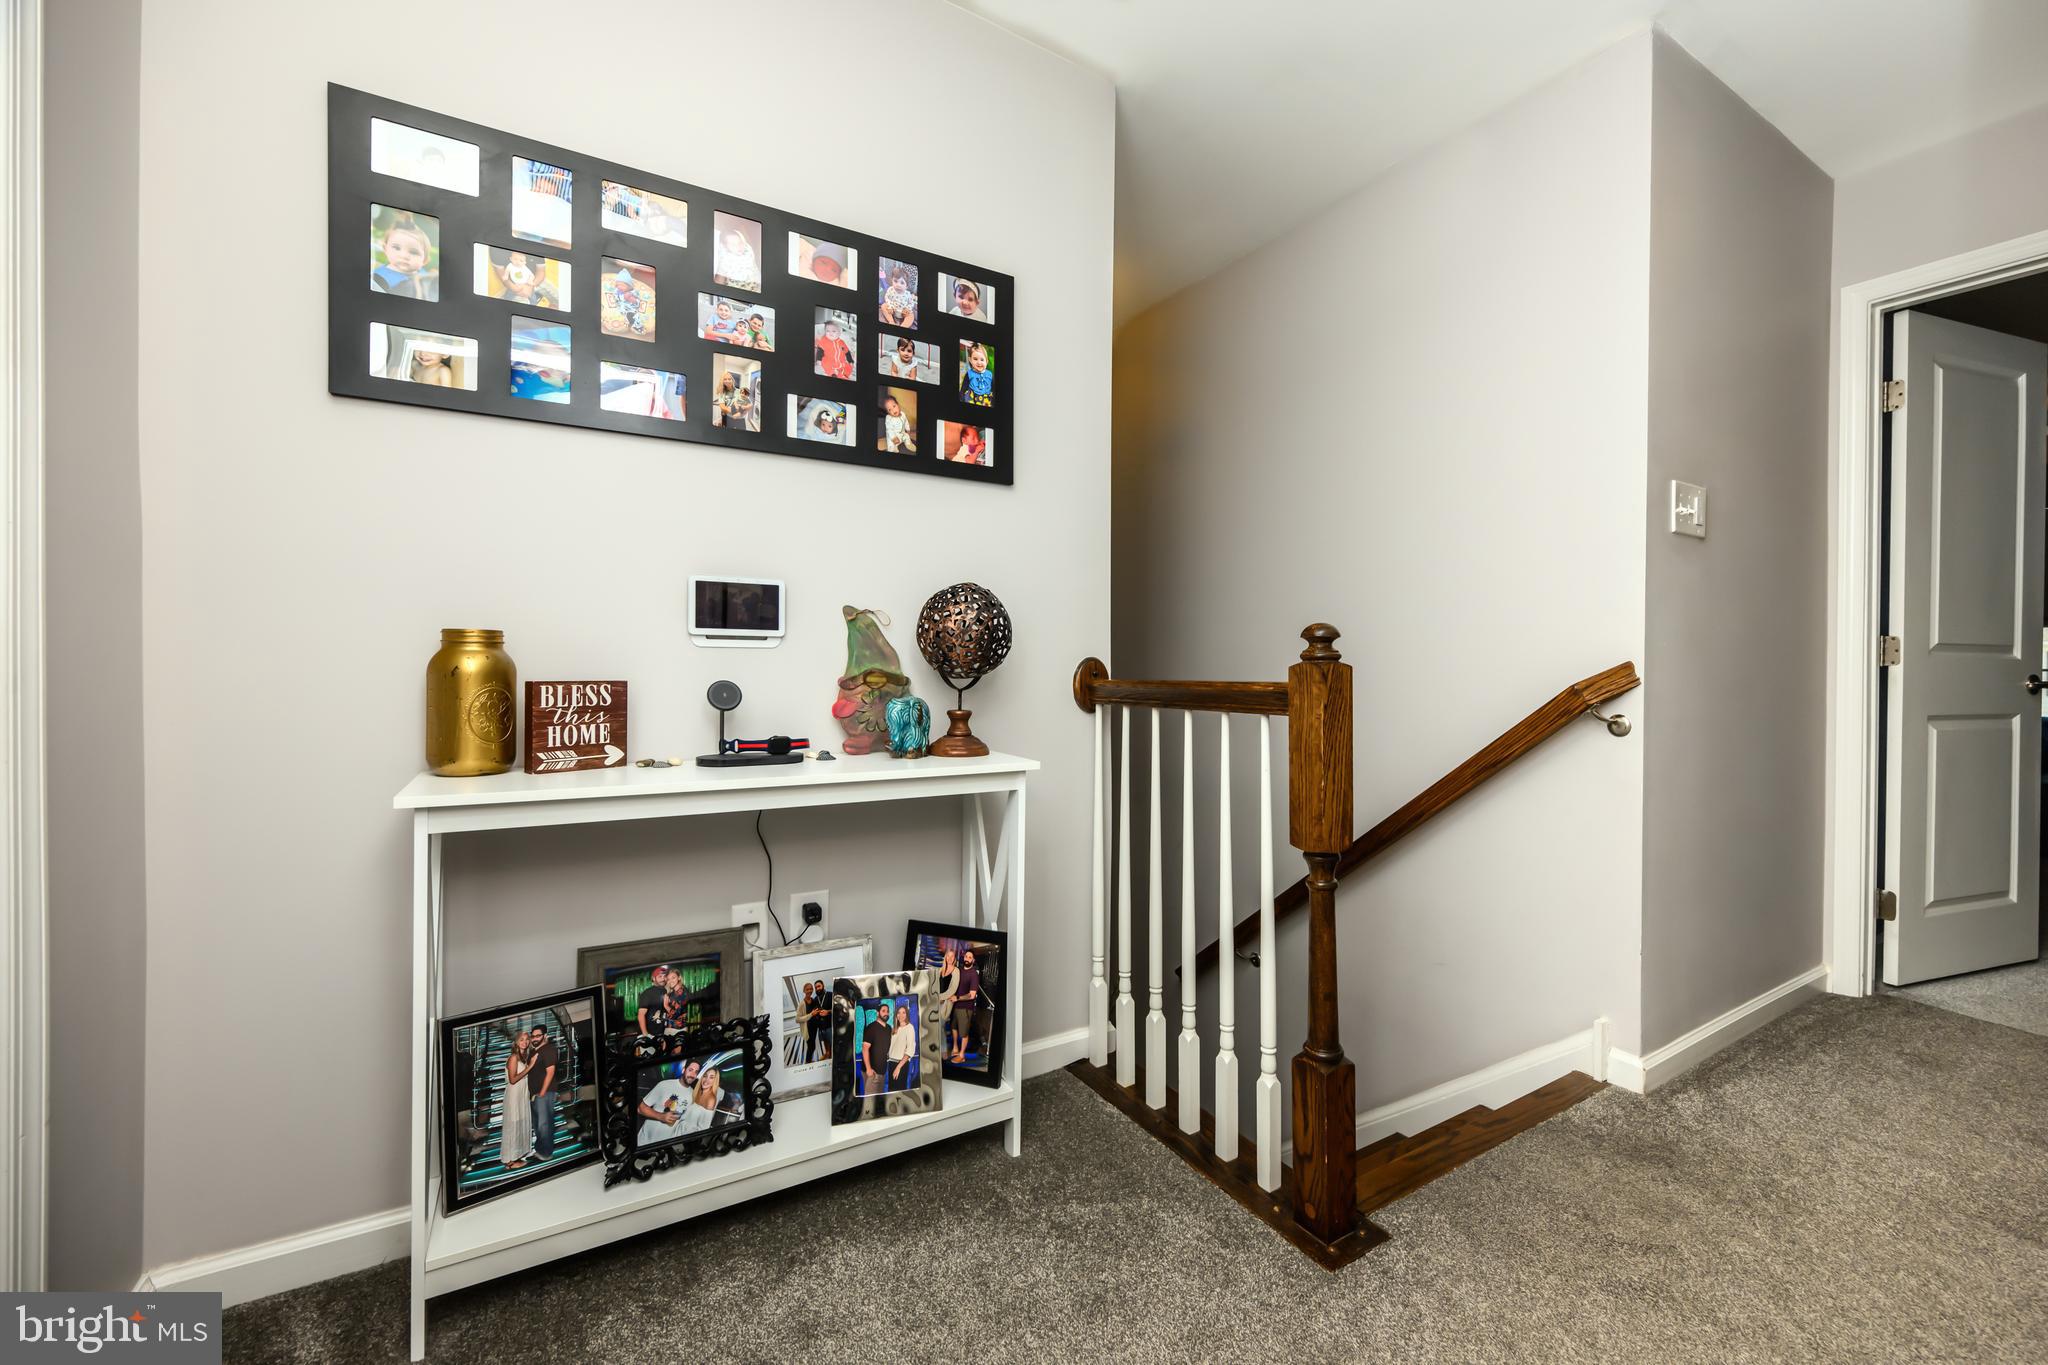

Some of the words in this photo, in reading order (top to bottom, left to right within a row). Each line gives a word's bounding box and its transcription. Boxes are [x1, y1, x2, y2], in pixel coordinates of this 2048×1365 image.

[540, 684, 612, 708] BLESS
[546, 705, 610, 725] this
[547, 723, 611, 748] HOME
